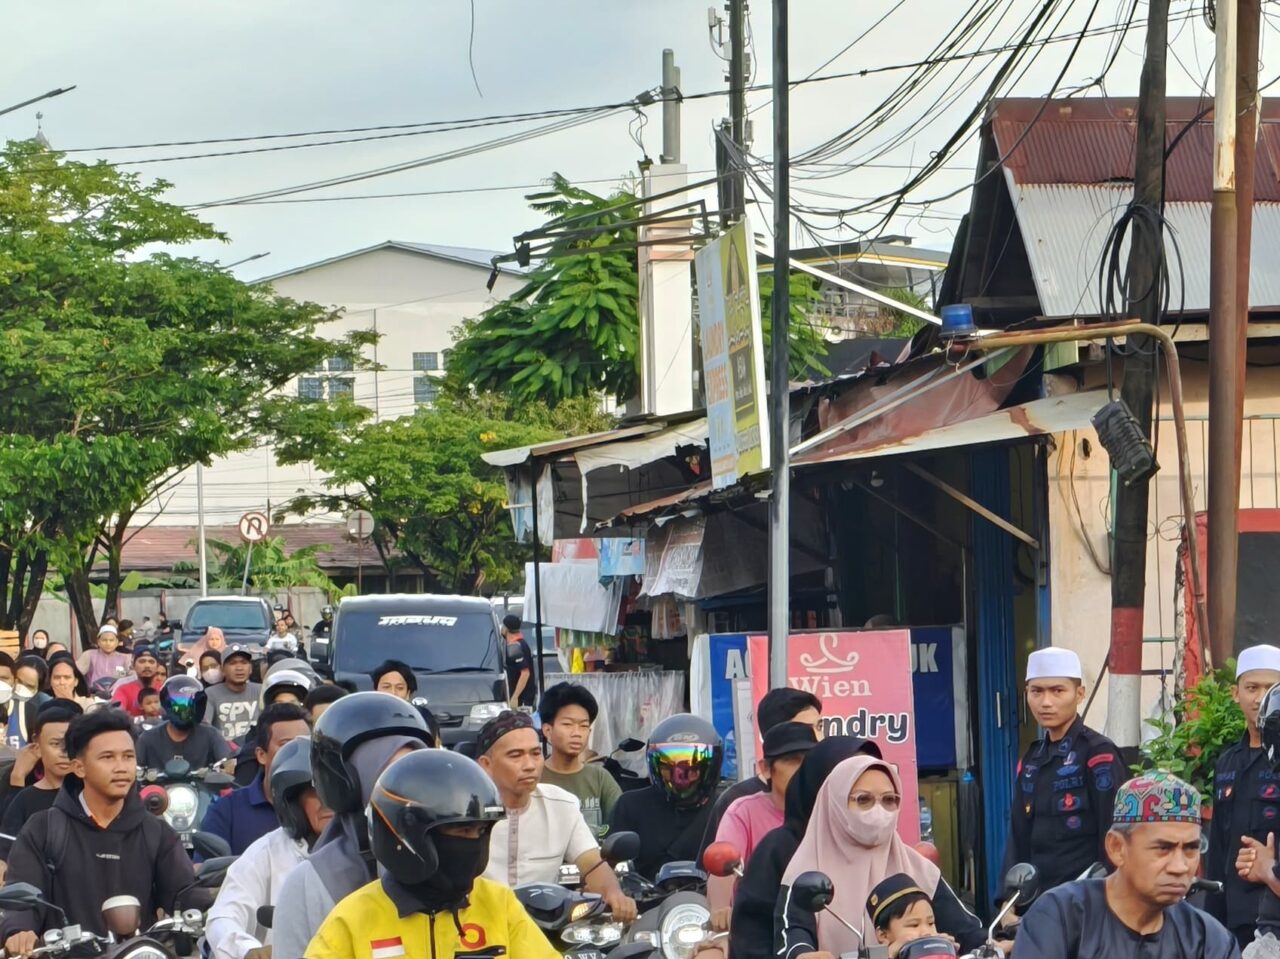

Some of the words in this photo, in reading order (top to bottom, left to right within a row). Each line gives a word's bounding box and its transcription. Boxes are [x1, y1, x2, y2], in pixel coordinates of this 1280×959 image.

[788, 675, 873, 699] Wien
[219, 701, 258, 721] SPY
[823, 707, 909, 742] ndry
